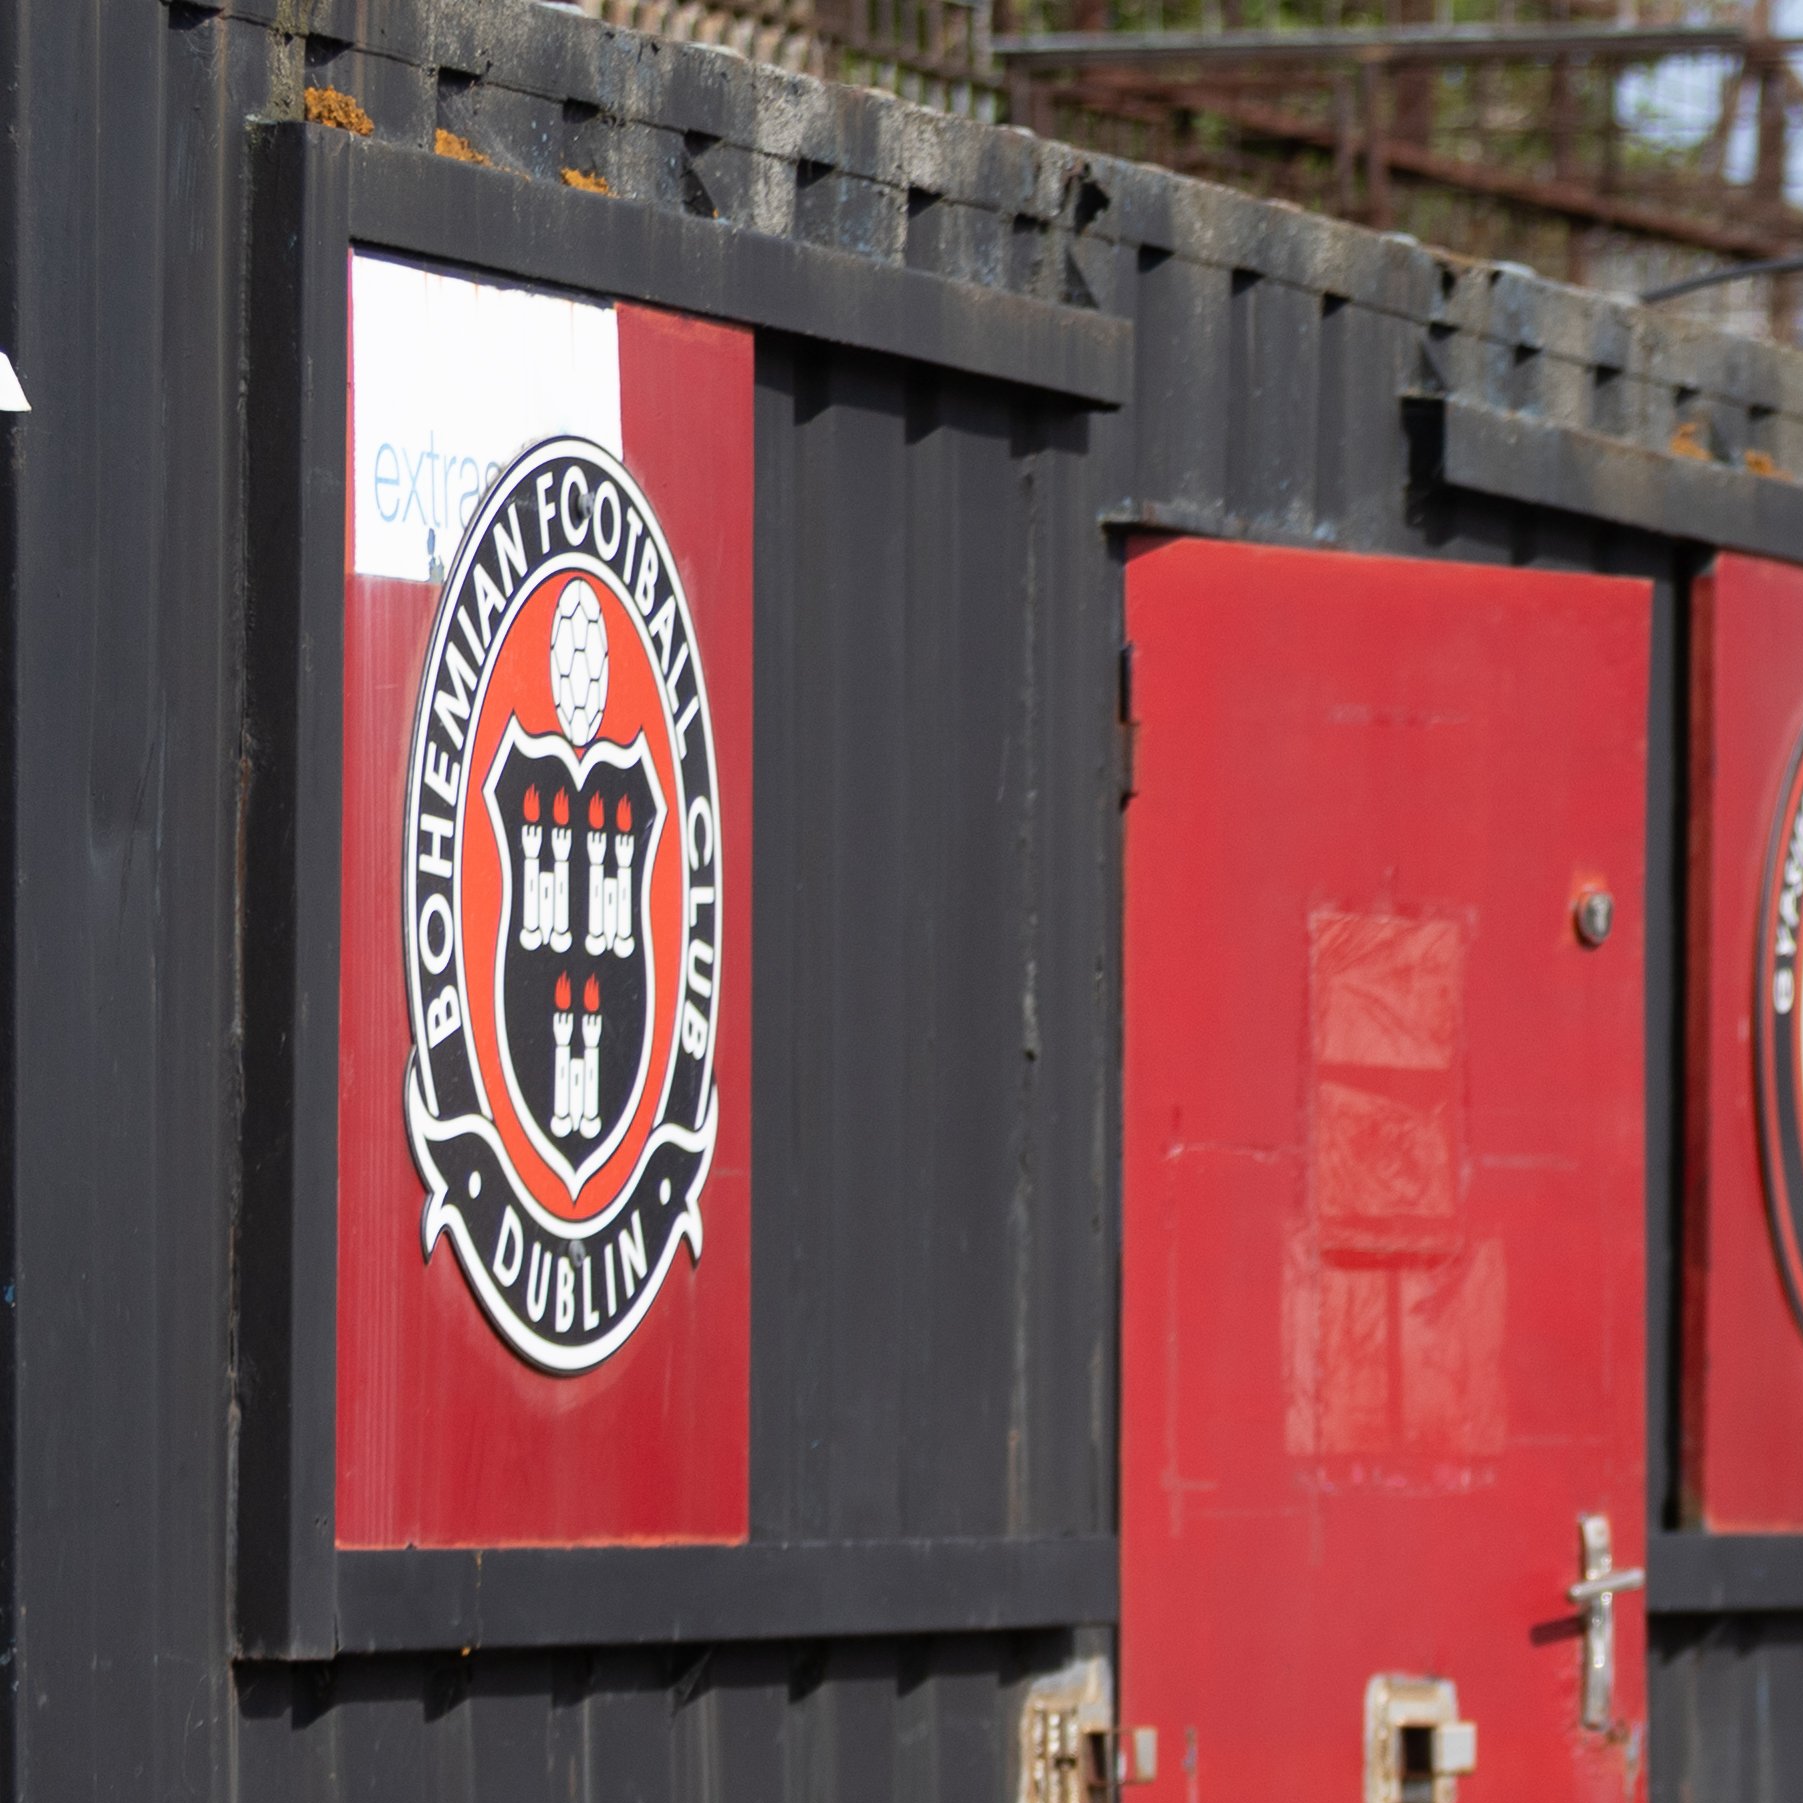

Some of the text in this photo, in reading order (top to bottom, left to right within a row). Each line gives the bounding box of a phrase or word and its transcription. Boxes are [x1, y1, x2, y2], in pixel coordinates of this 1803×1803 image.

[419, 465, 715, 1060] BOHEMIAN FOOTBALL CLUB
[492, 1204, 648, 1333] DUBLIN
